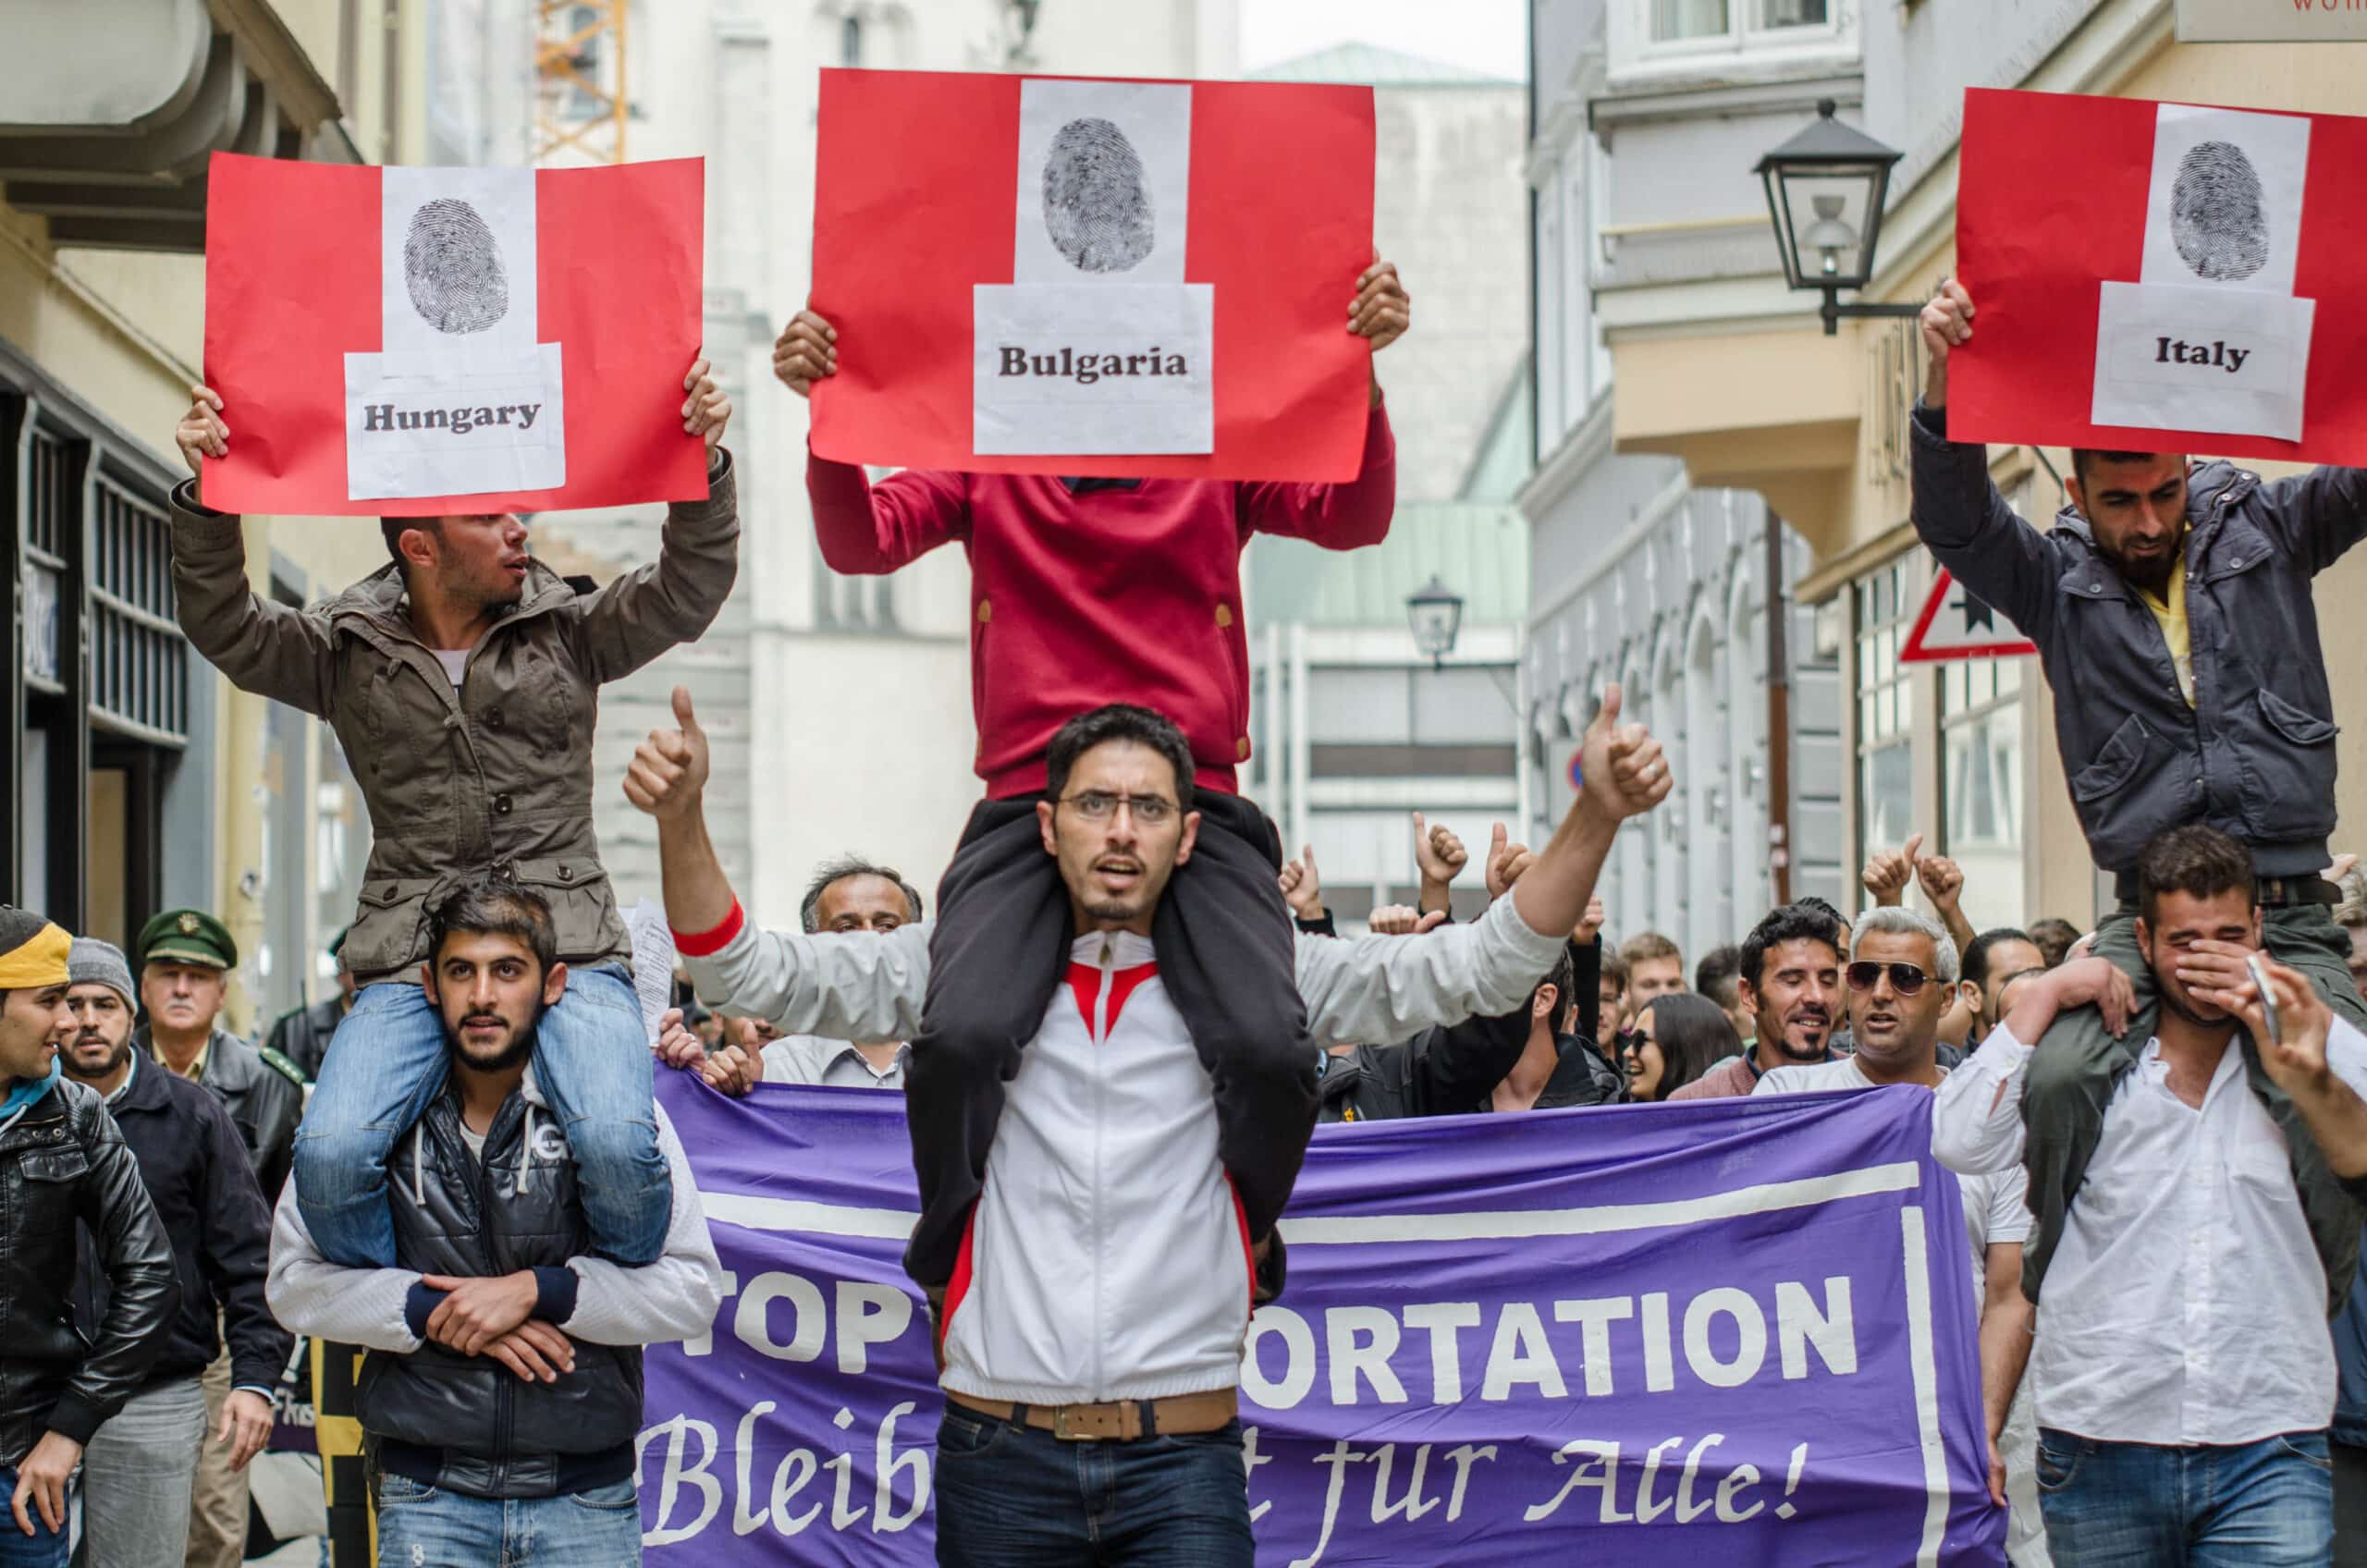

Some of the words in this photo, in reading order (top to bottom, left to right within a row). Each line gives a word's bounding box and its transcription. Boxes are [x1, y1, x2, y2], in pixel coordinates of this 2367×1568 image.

[999, 347, 1188, 384] Bulgaria
[2155, 337, 2250, 373] Italy
[364, 403, 542, 434] Hungary
[1240, 1276, 1858, 1409] ORTATION
[634, 1401, 932, 1547] Bleib
[1523, 1433, 1808, 1525] Alle!
